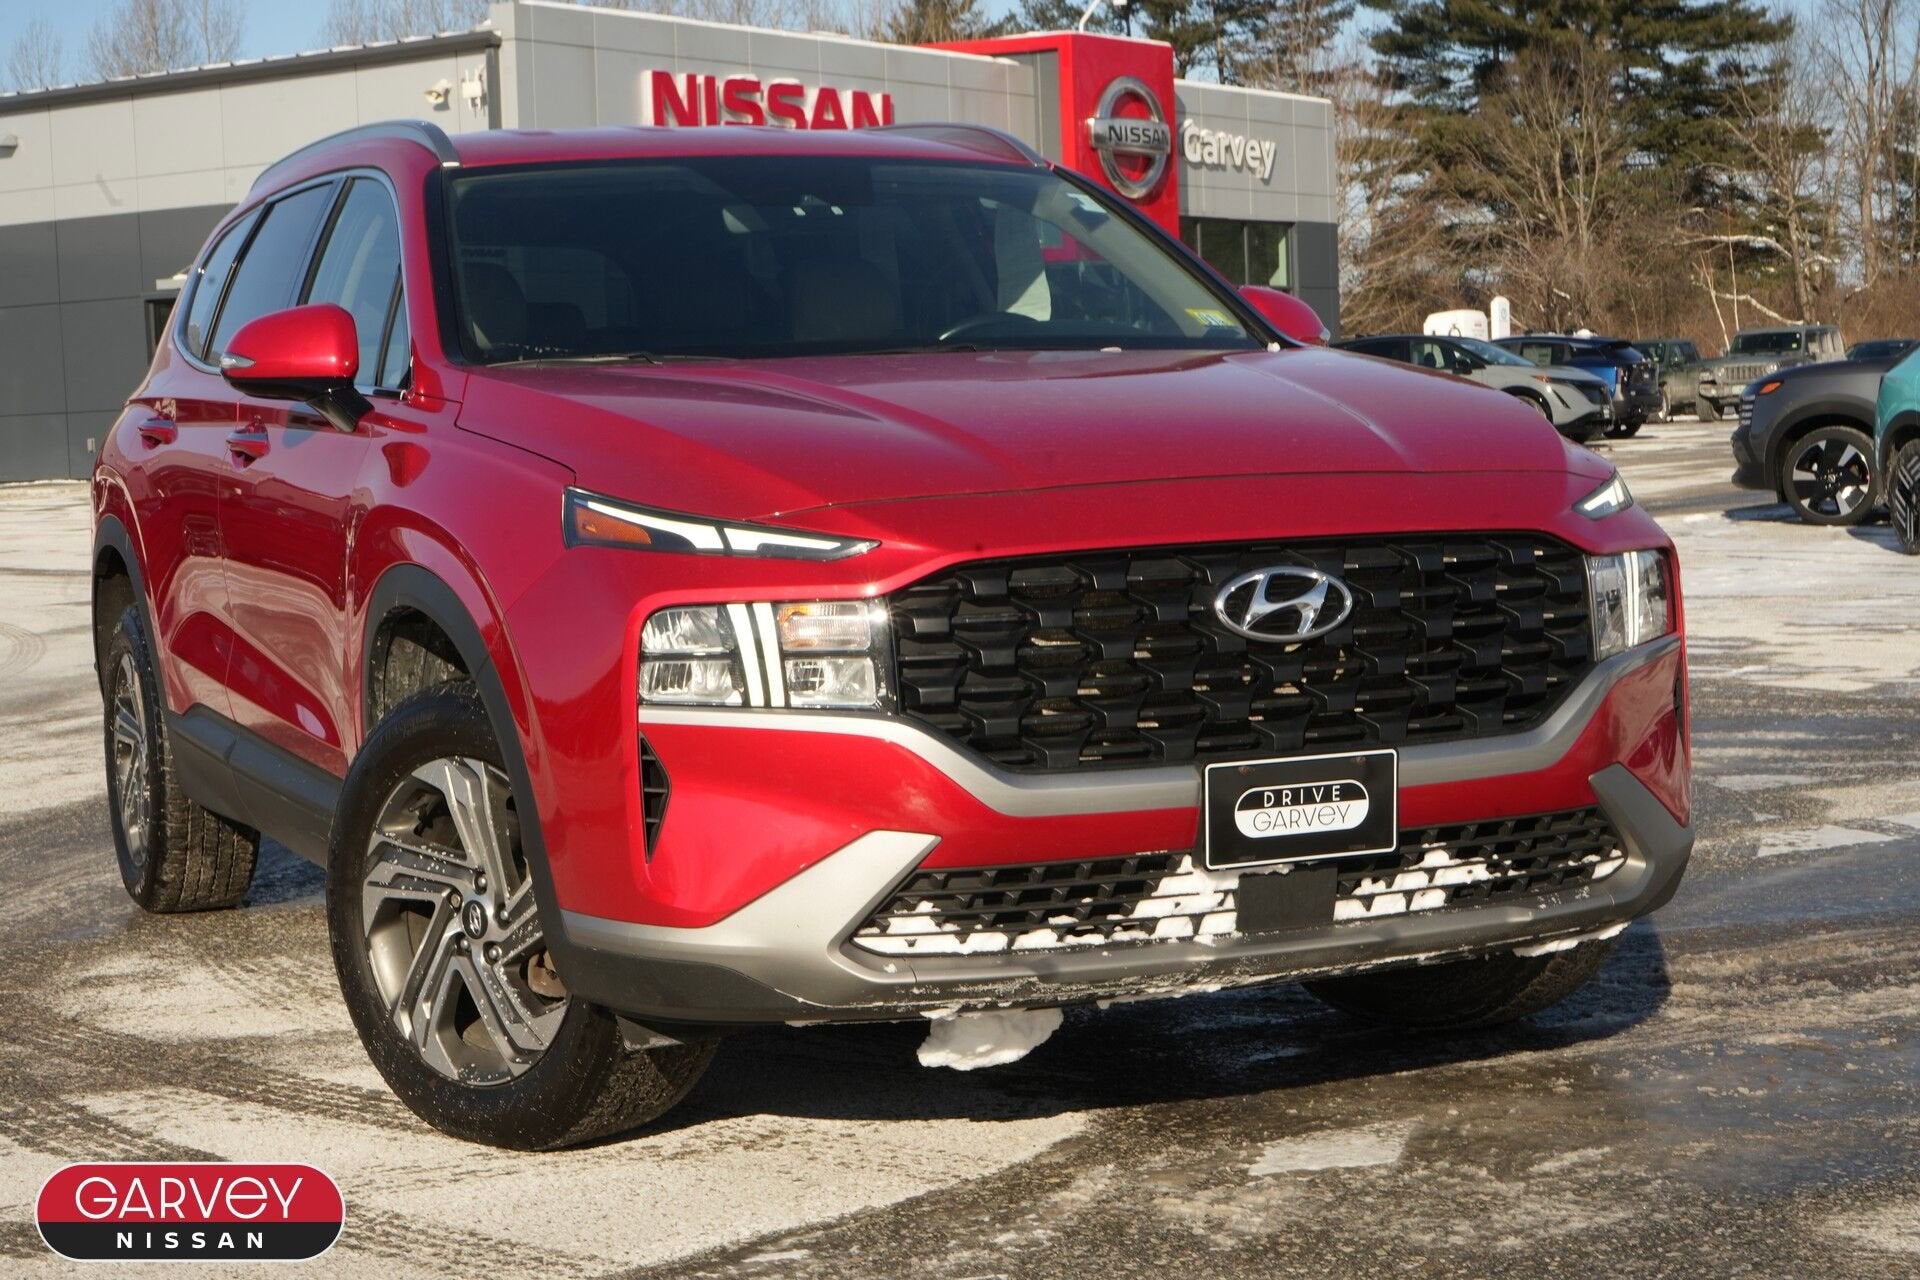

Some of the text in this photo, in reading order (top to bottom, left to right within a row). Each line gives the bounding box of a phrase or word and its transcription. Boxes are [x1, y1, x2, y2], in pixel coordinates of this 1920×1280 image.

[648, 70, 894, 130] NISSAN
[1107, 125, 1170, 147] NISSAN
[1183, 118, 1276, 179] Garvey
[1263, 785, 1341, 808] DRIVE
